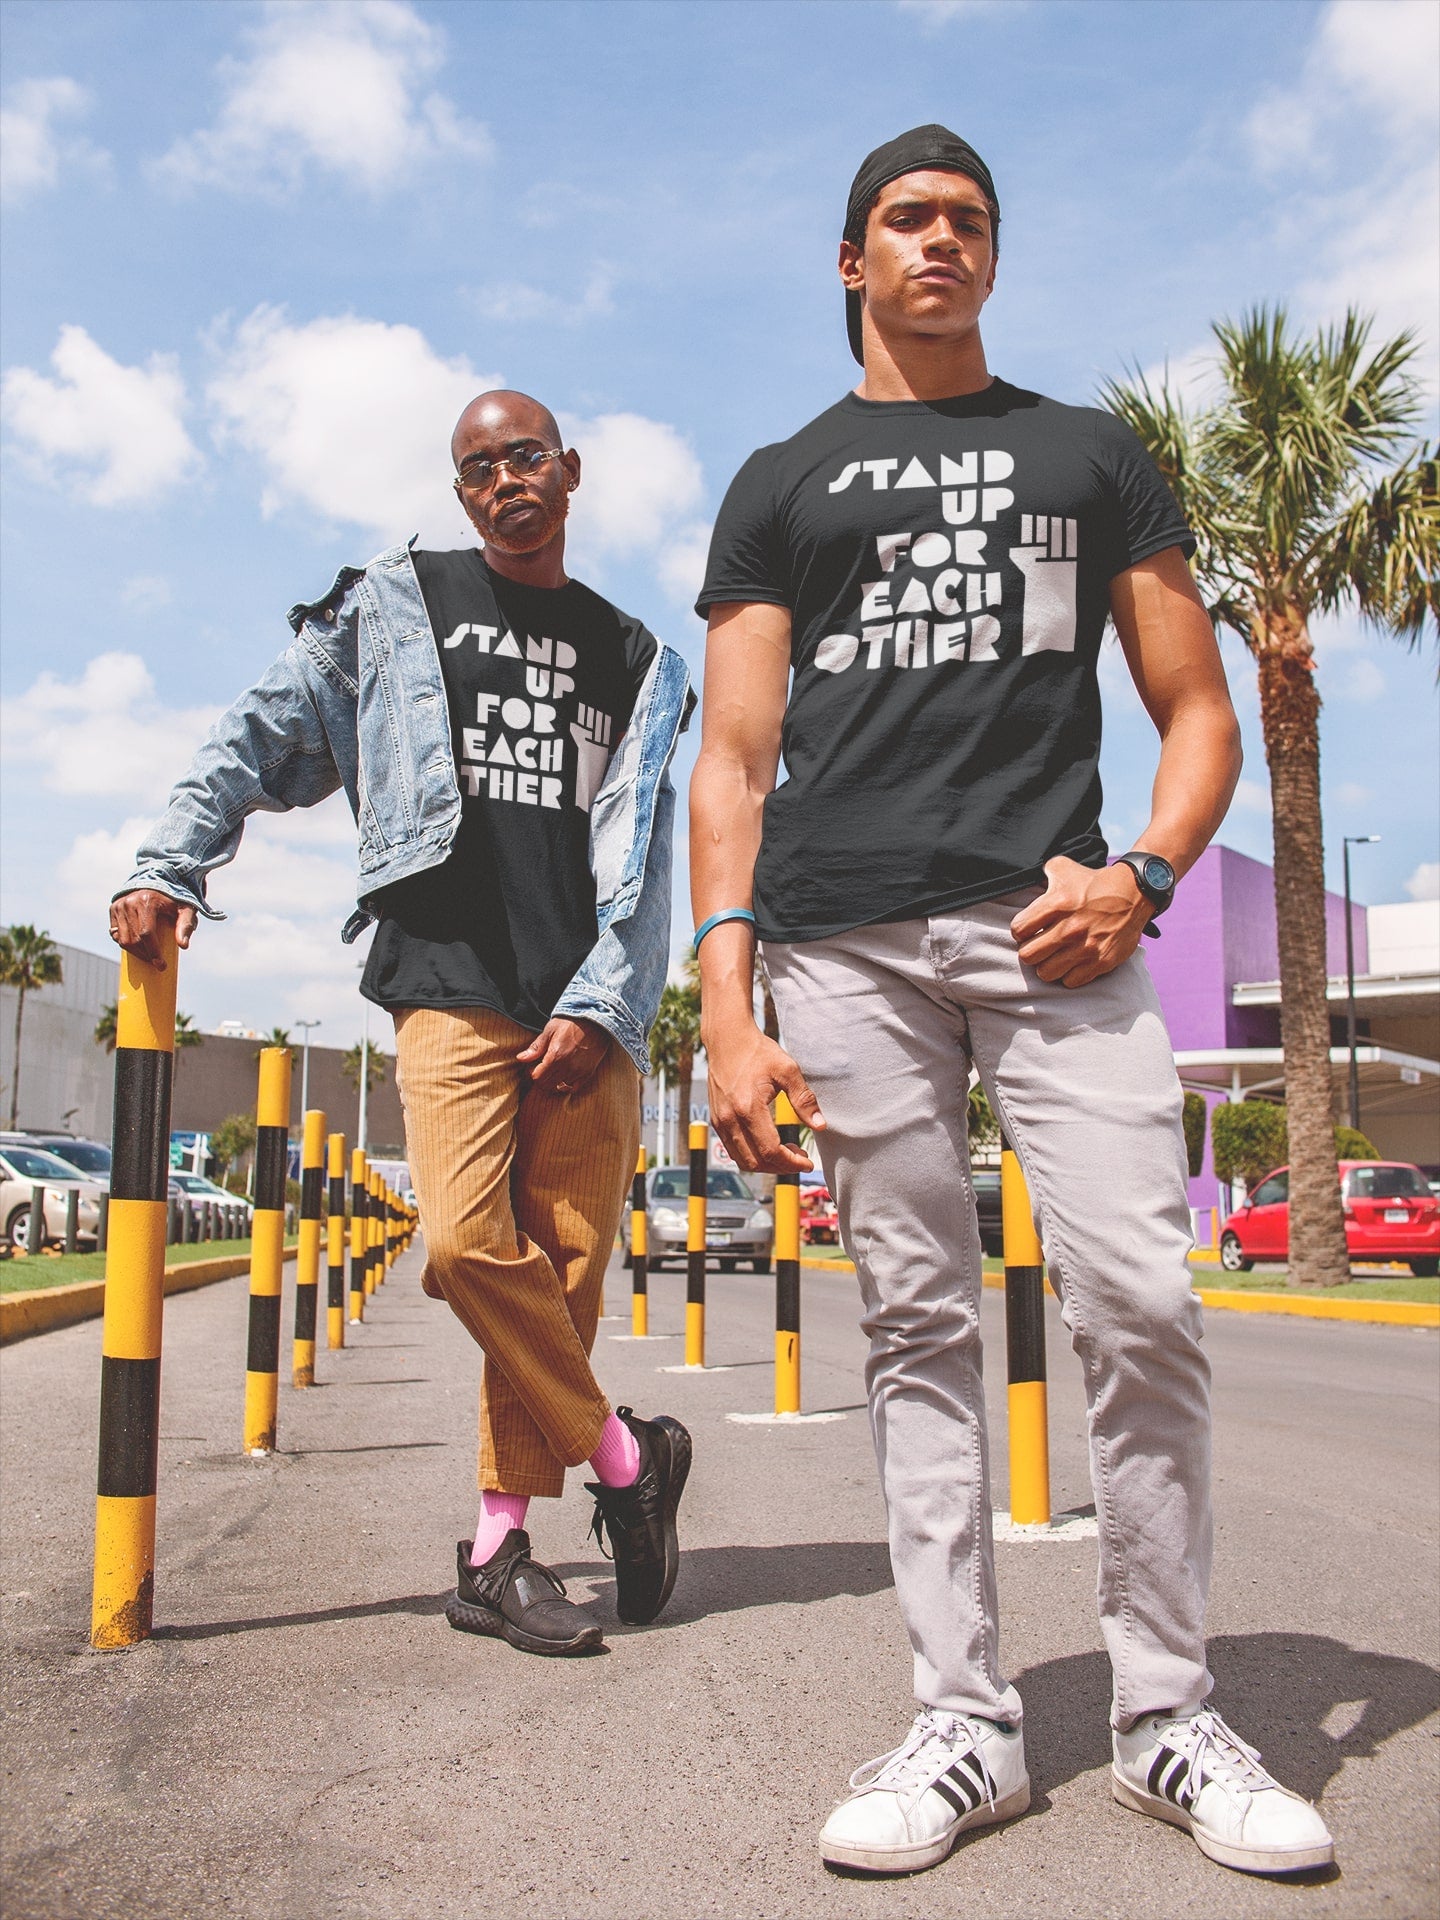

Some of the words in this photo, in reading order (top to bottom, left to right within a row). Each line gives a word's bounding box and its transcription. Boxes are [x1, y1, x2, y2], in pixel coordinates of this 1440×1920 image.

[828, 450, 1014, 493] STAND
[942, 487, 1014, 525] UP
[876, 530, 987, 572] FOR
[861, 568, 1002, 622] EACH
[444, 623, 577, 669] STAND
[814, 614, 1001, 674] OTHER
[526, 666, 575, 699] UP
[477, 692, 557, 734] FOR
[463, 727, 564, 772] EACH
[457, 764, 562, 810] THER
